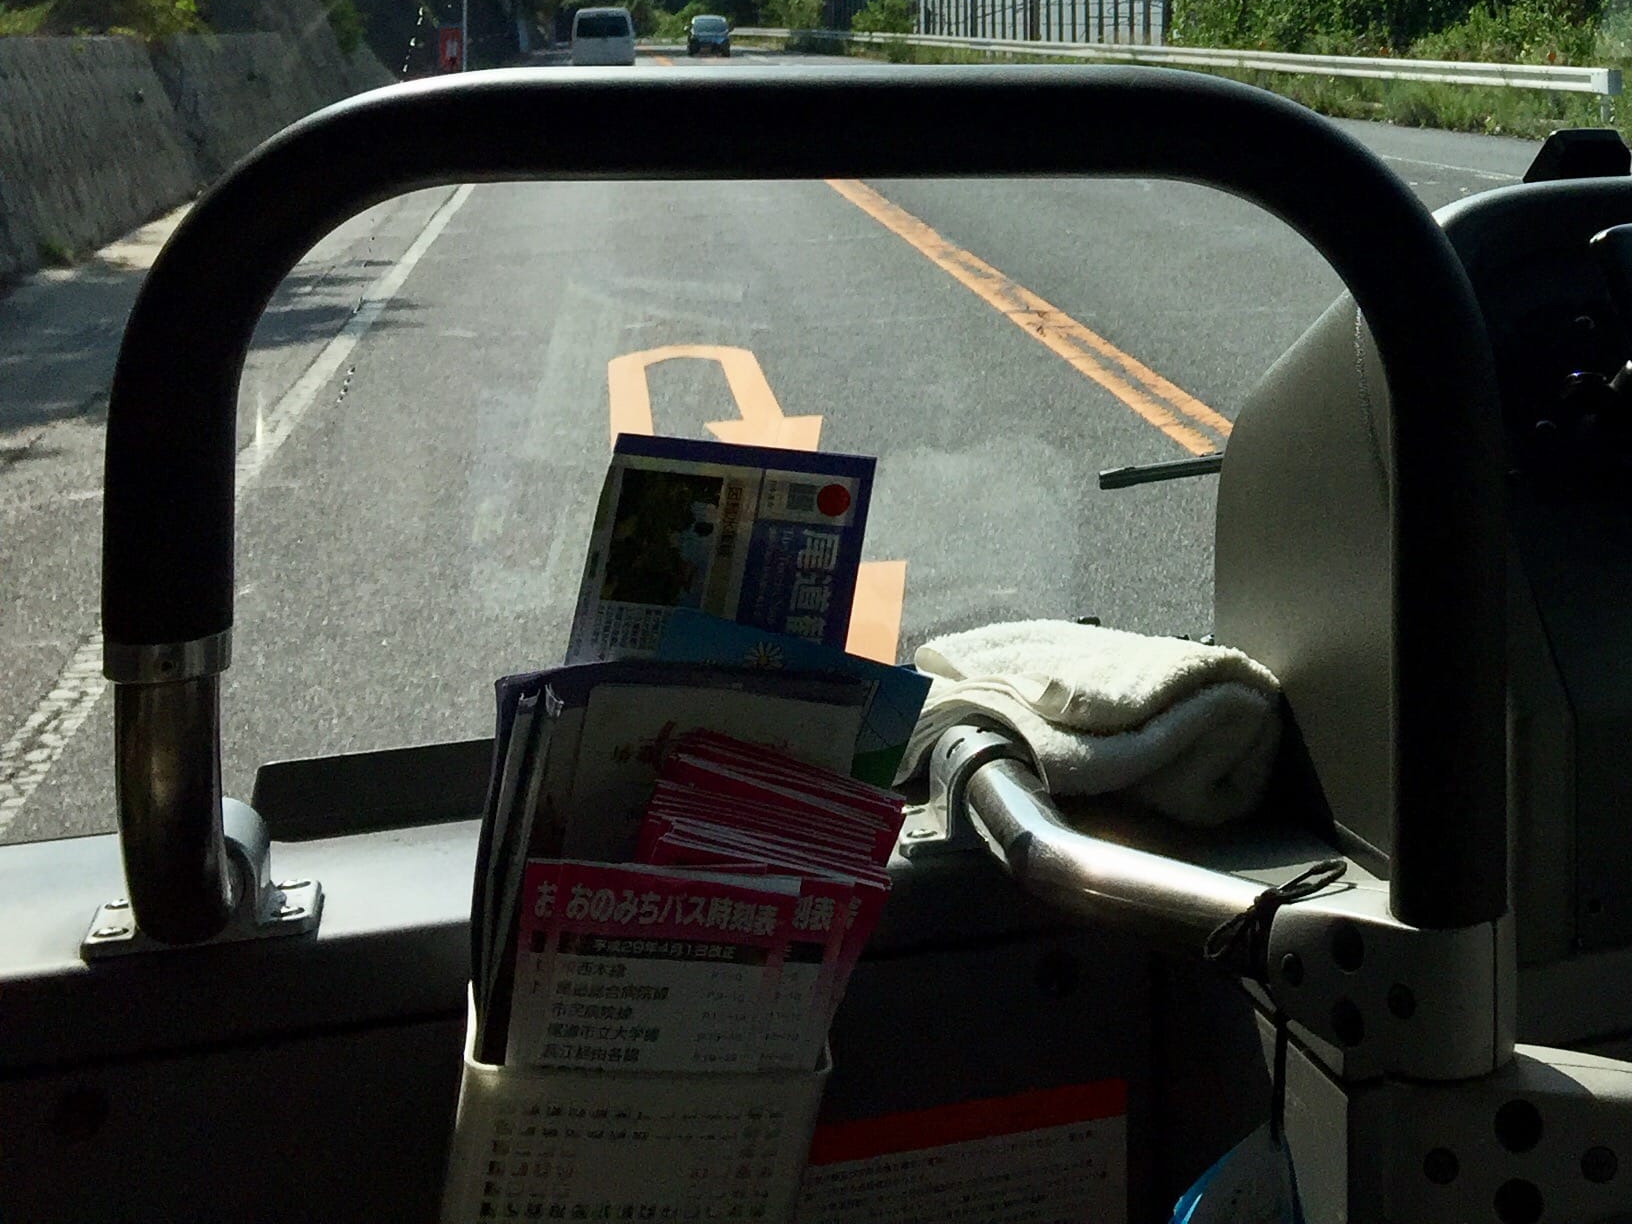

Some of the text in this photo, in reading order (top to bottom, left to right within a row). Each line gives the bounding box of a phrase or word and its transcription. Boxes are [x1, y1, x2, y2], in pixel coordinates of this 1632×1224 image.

[566, 881, 780, 937] おのみちバス時刻表
